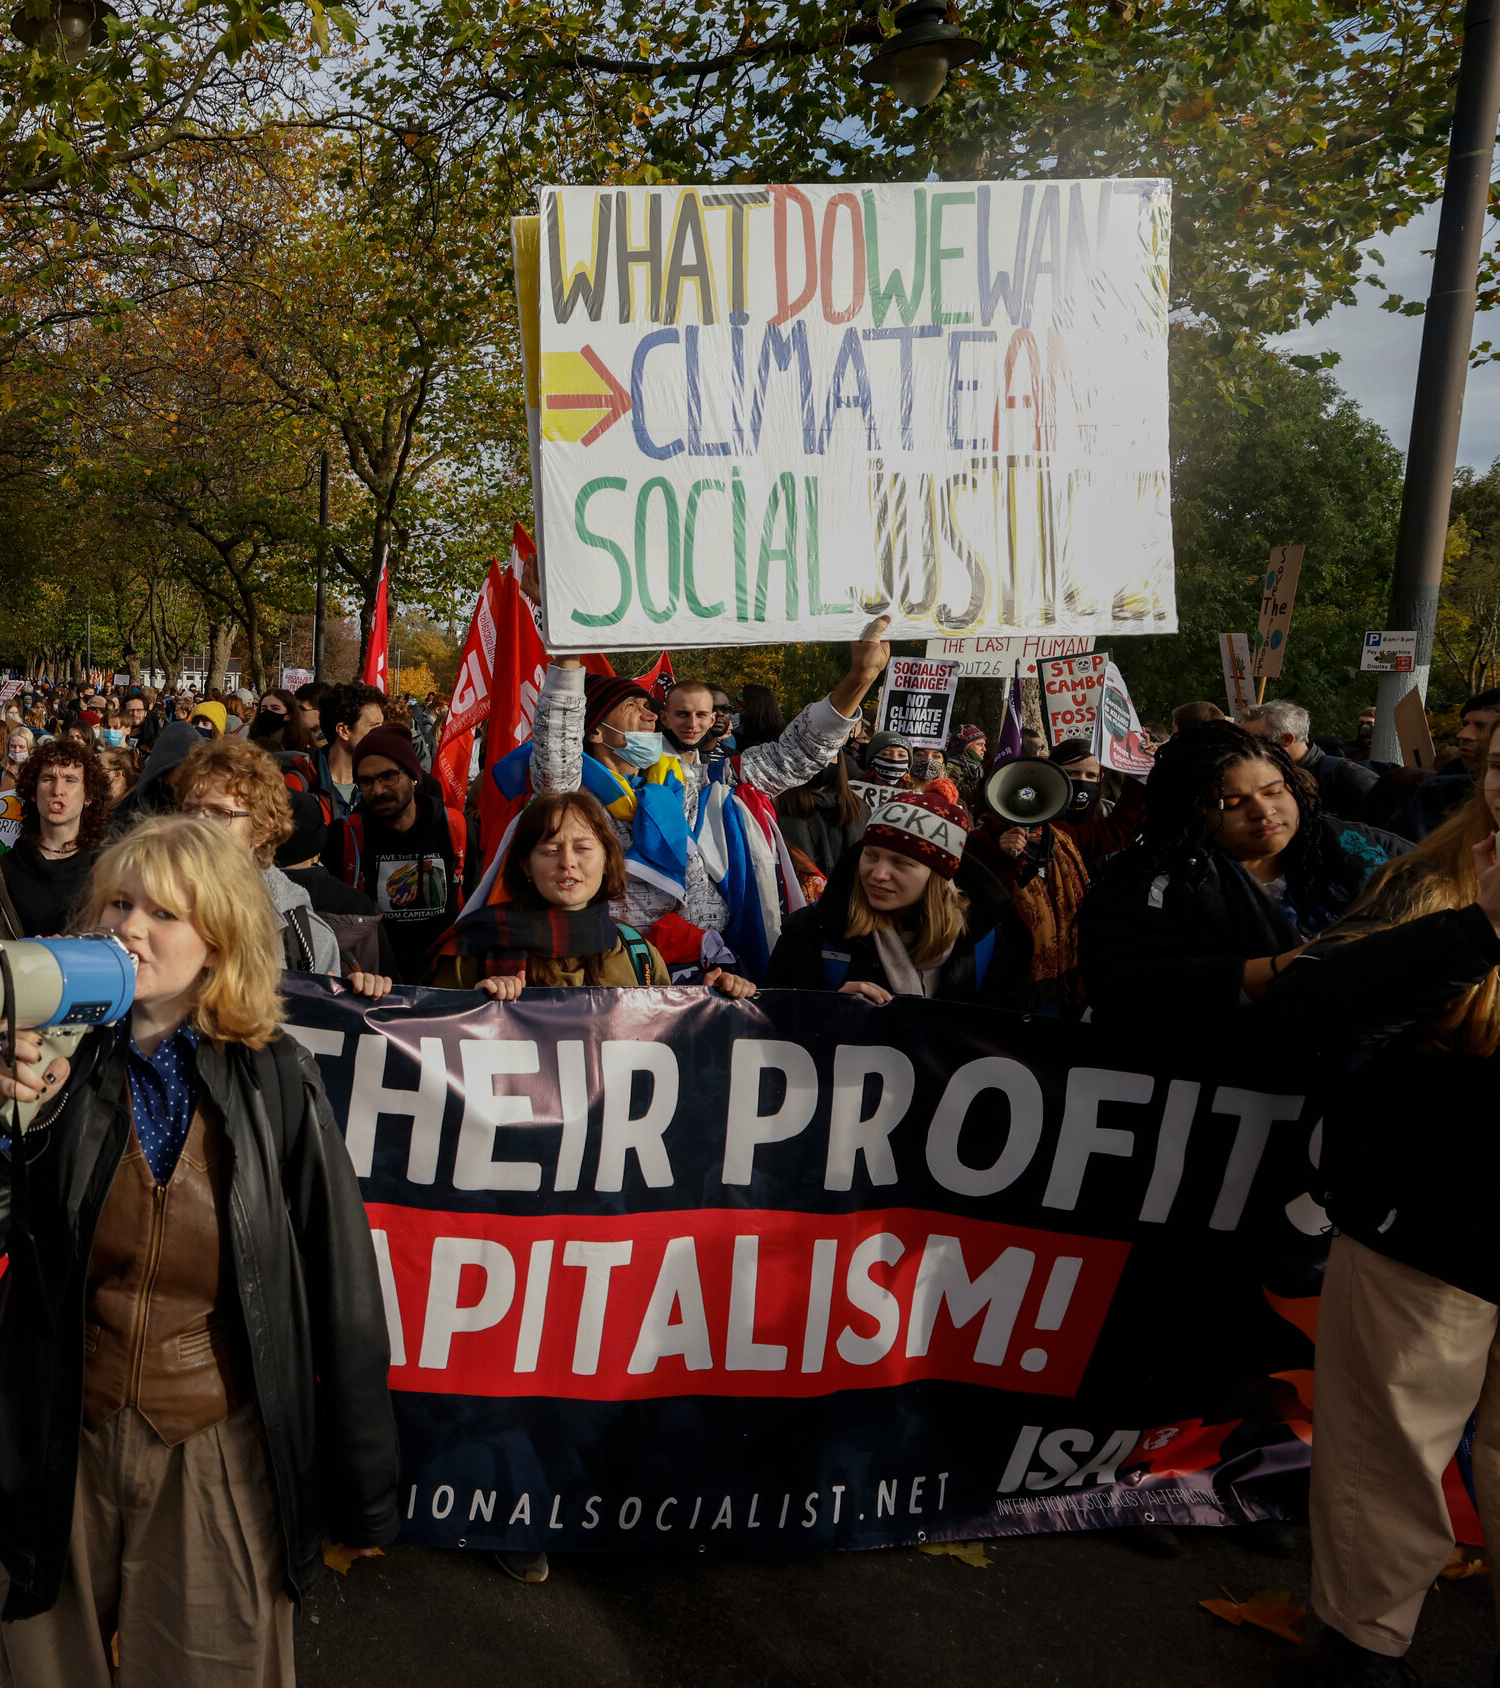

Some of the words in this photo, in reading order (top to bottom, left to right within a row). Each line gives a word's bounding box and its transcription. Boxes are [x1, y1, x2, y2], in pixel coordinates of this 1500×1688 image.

[548, 187, 774, 325] WHAT
[764, 183, 866, 326] DO
[862, 187, 977, 328] WE
[1263, 597, 1288, 617] The
[943, 638, 966, 654] THE
[975, 637, 1011, 653] LAST
[1023, 636, 1089, 658] HUMAN
[1369, 634, 1380, 646] P
[894, 661, 956, 678] SOCIALIST
[895, 675, 948, 691] CHANGE!
[906, 693, 931, 708] NOT
[1071, 693, 1087, 707] U
[890, 706, 943, 722] CLIMATE
[1050, 706, 1098, 727] FOSS
[889, 719, 938, 735] CHANGE
[403, 908, 446, 918] CAPITALISM
[997, 1425, 1141, 1493] ISA
[407, 1472, 950, 1532] IONALSOCIALIST.NET
[996, 1495, 1083, 1516] INTERNATIONAL
[1083, 1490, 1144, 1510] SOCIALIST
[1149, 1488, 1224, 1506] ALTERNATIVE
